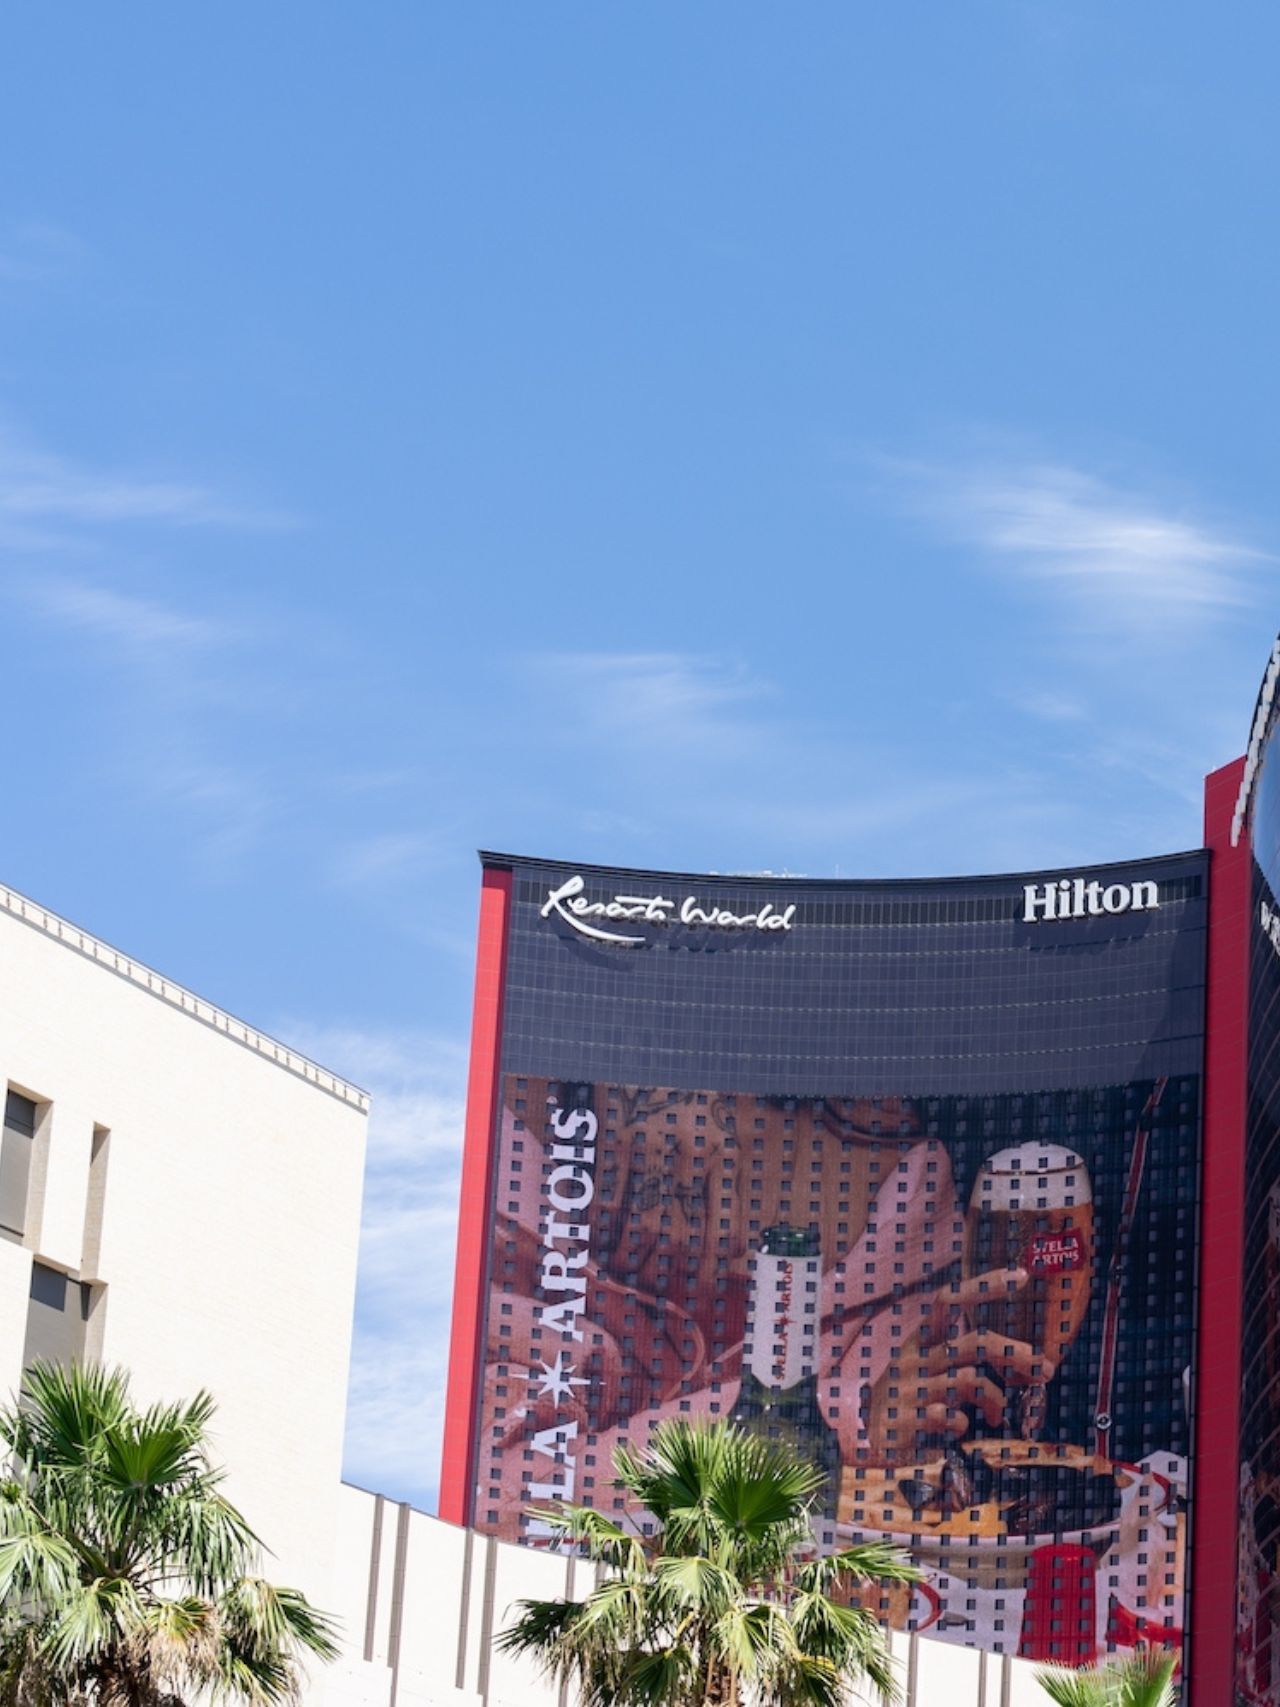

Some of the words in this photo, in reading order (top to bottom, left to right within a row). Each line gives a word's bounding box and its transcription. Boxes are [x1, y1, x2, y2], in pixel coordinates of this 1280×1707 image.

[680, 896, 796, 931] World
[1022, 878, 1160, 922] Hilton
[540, 1107, 598, 1342] ARTOIS
